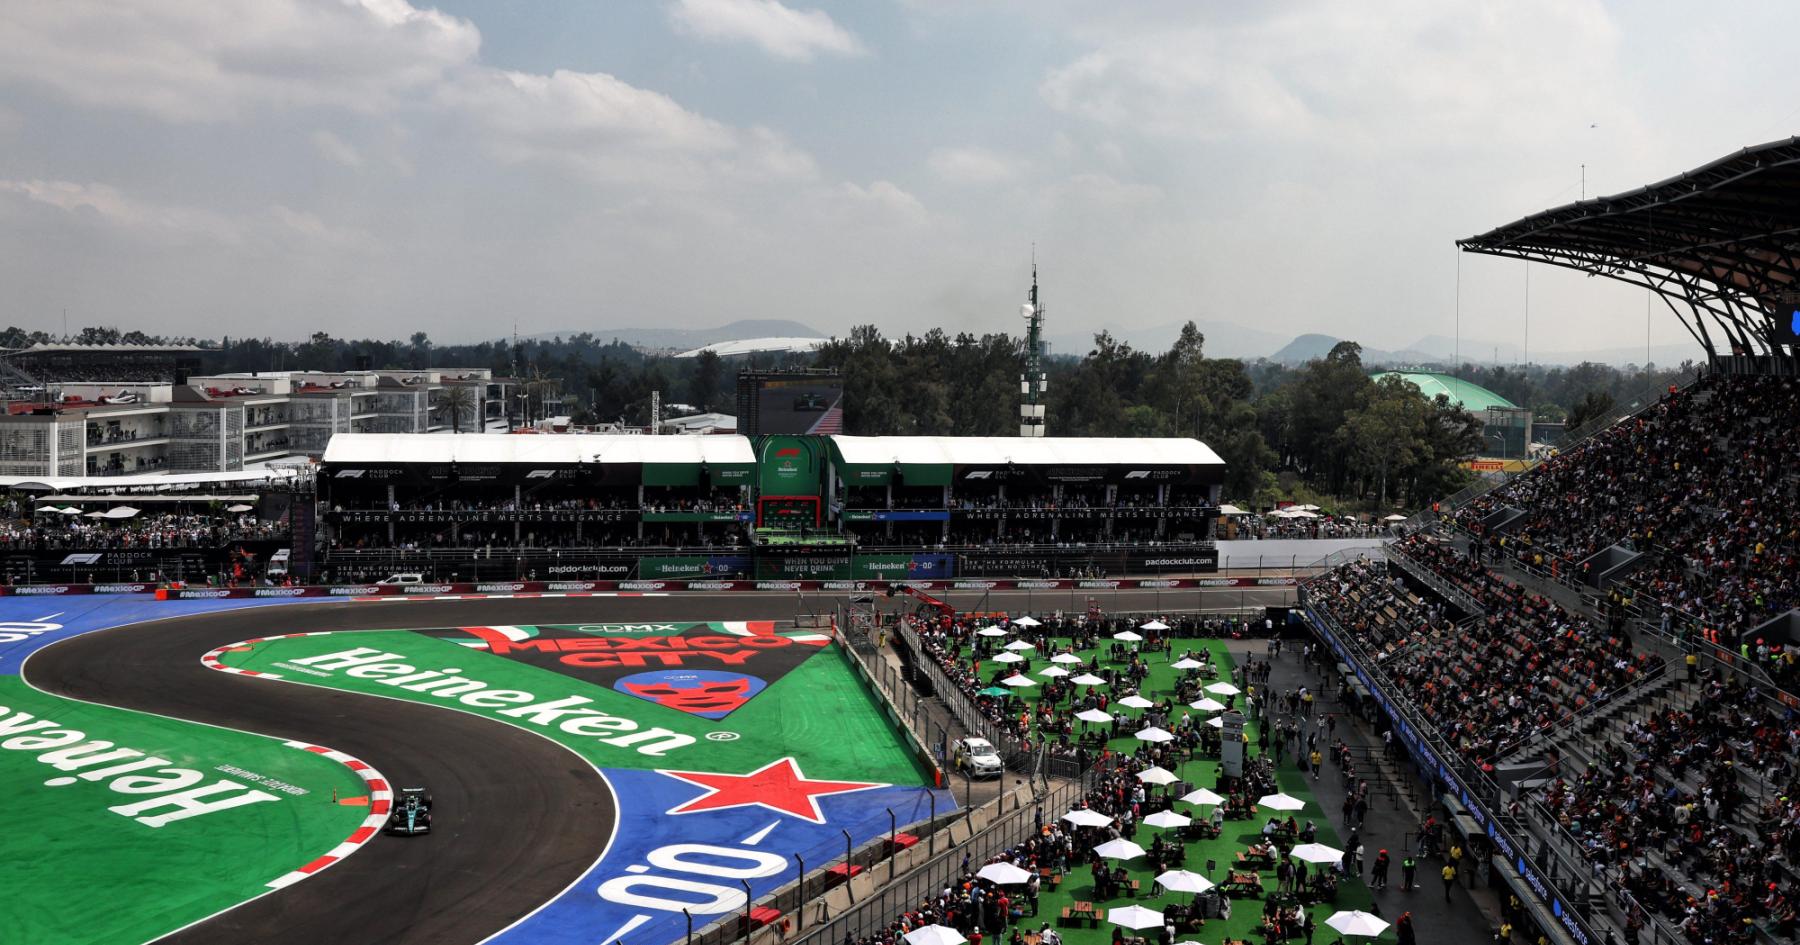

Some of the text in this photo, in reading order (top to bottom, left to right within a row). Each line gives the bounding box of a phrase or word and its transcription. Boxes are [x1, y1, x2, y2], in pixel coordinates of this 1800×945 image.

[343, 514, 390, 522] WHERE
[400, 514, 489, 522] ADRENALINE
[809, 557, 825, 565] YOU
[1145, 558, 1212, 566] paddockclub.com
[661, 564, 700, 573] Heineken
[784, 564, 834, 572] NEVER DRINK
[869, 562, 905, 570] Heineken
[15, 586, 69, 594] #MexicoGP
[94, 584, 145, 593] #MexicoGP
[330, 587, 380, 595] #MexicoGP
[404, 585, 453, 593] #MexicoGP
[477, 584, 525, 592] #MexicoGP
[180, 590, 231, 598] #MexicoGP
[255, 588, 306, 597] #MexicoGP
[578, 624, 678, 633] CDMX
[487, 635, 794, 654] MEXICO
[559, 650, 760, 667] CITY
[288, 647, 697, 756] Heineken
